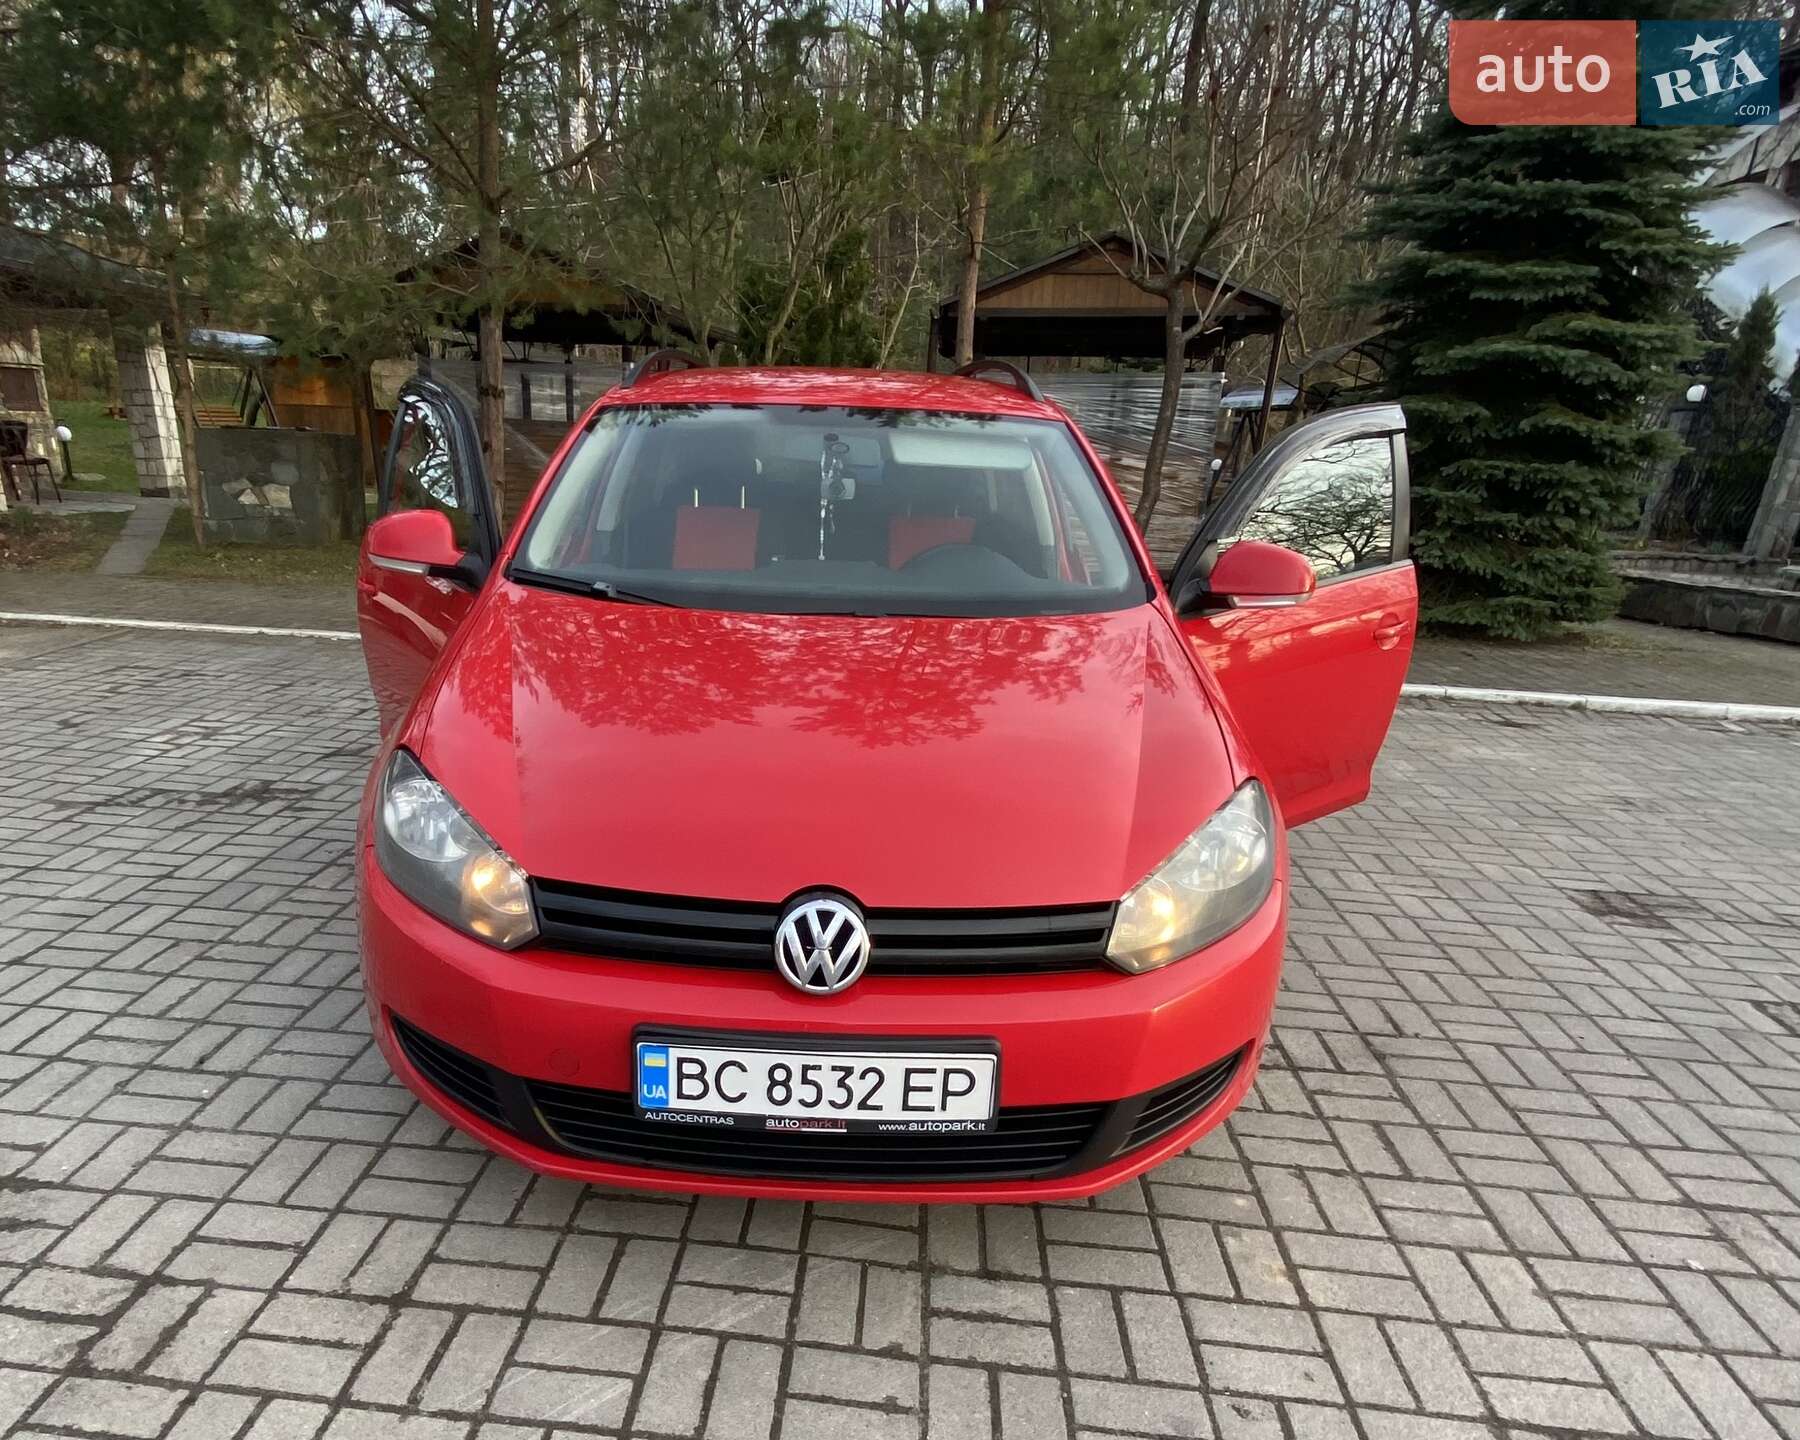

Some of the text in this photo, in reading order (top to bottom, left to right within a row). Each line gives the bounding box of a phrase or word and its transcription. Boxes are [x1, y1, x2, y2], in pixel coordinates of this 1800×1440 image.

[643, 1084, 667, 1099] UA
[675, 1056, 976, 1112] BC 8532 EP
[644, 1111, 735, 1126] AUTOCENTRAS
[878, 1120, 986, 1133] www.autopark.lt
